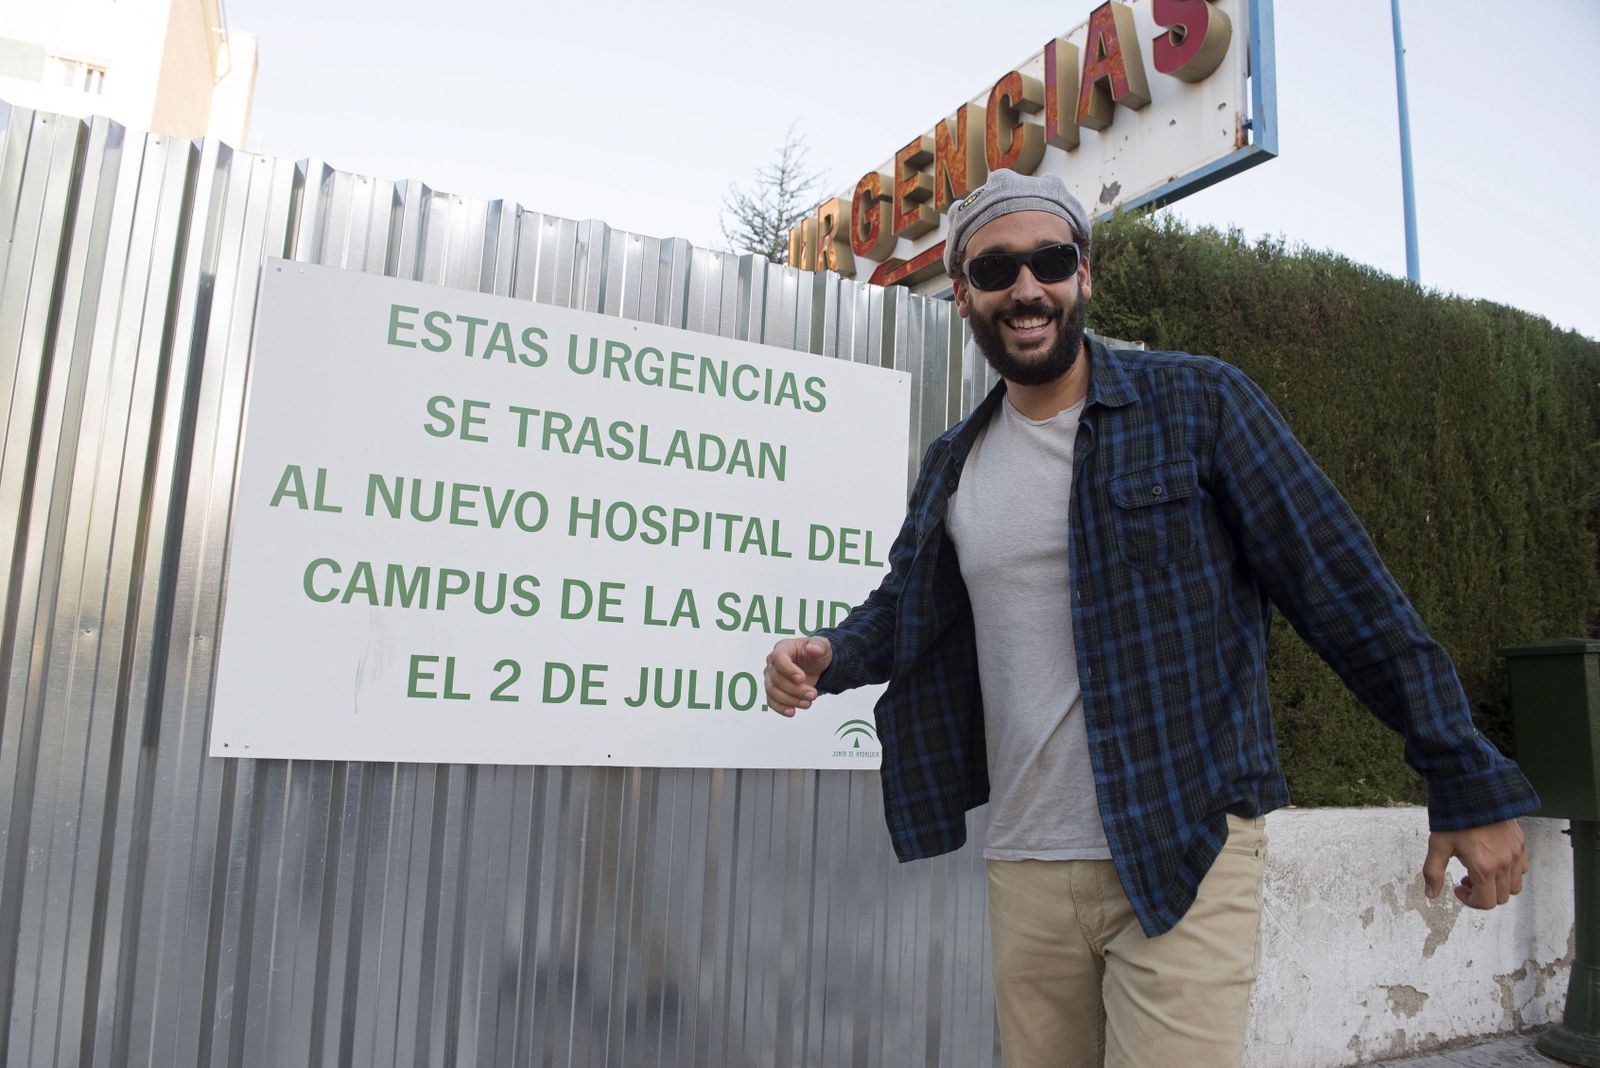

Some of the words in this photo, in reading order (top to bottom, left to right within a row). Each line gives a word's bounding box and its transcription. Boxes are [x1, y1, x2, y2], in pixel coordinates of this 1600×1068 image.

[387, 303, 549, 368] ESTAS
[568, 333, 828, 413] URGENCIAS
[423, 395, 491, 443] SE
[509, 405, 788, 480] TRASLADAN
[270, 464, 342, 512] AL
[364, 473, 549, 533] NUEVO
[567, 496, 794, 558] HOSPITAL
[808, 523, 885, 569] DEL
[303, 556, 541, 619] CAMPUS
[560, 577, 625, 624] DE
[643, 585, 701, 629] LA
[405, 655, 470, 701] EL
[488, 658, 523, 703] 2
[542, 662, 609, 705] DE
[624, 666, 769, 713] JULIO.
